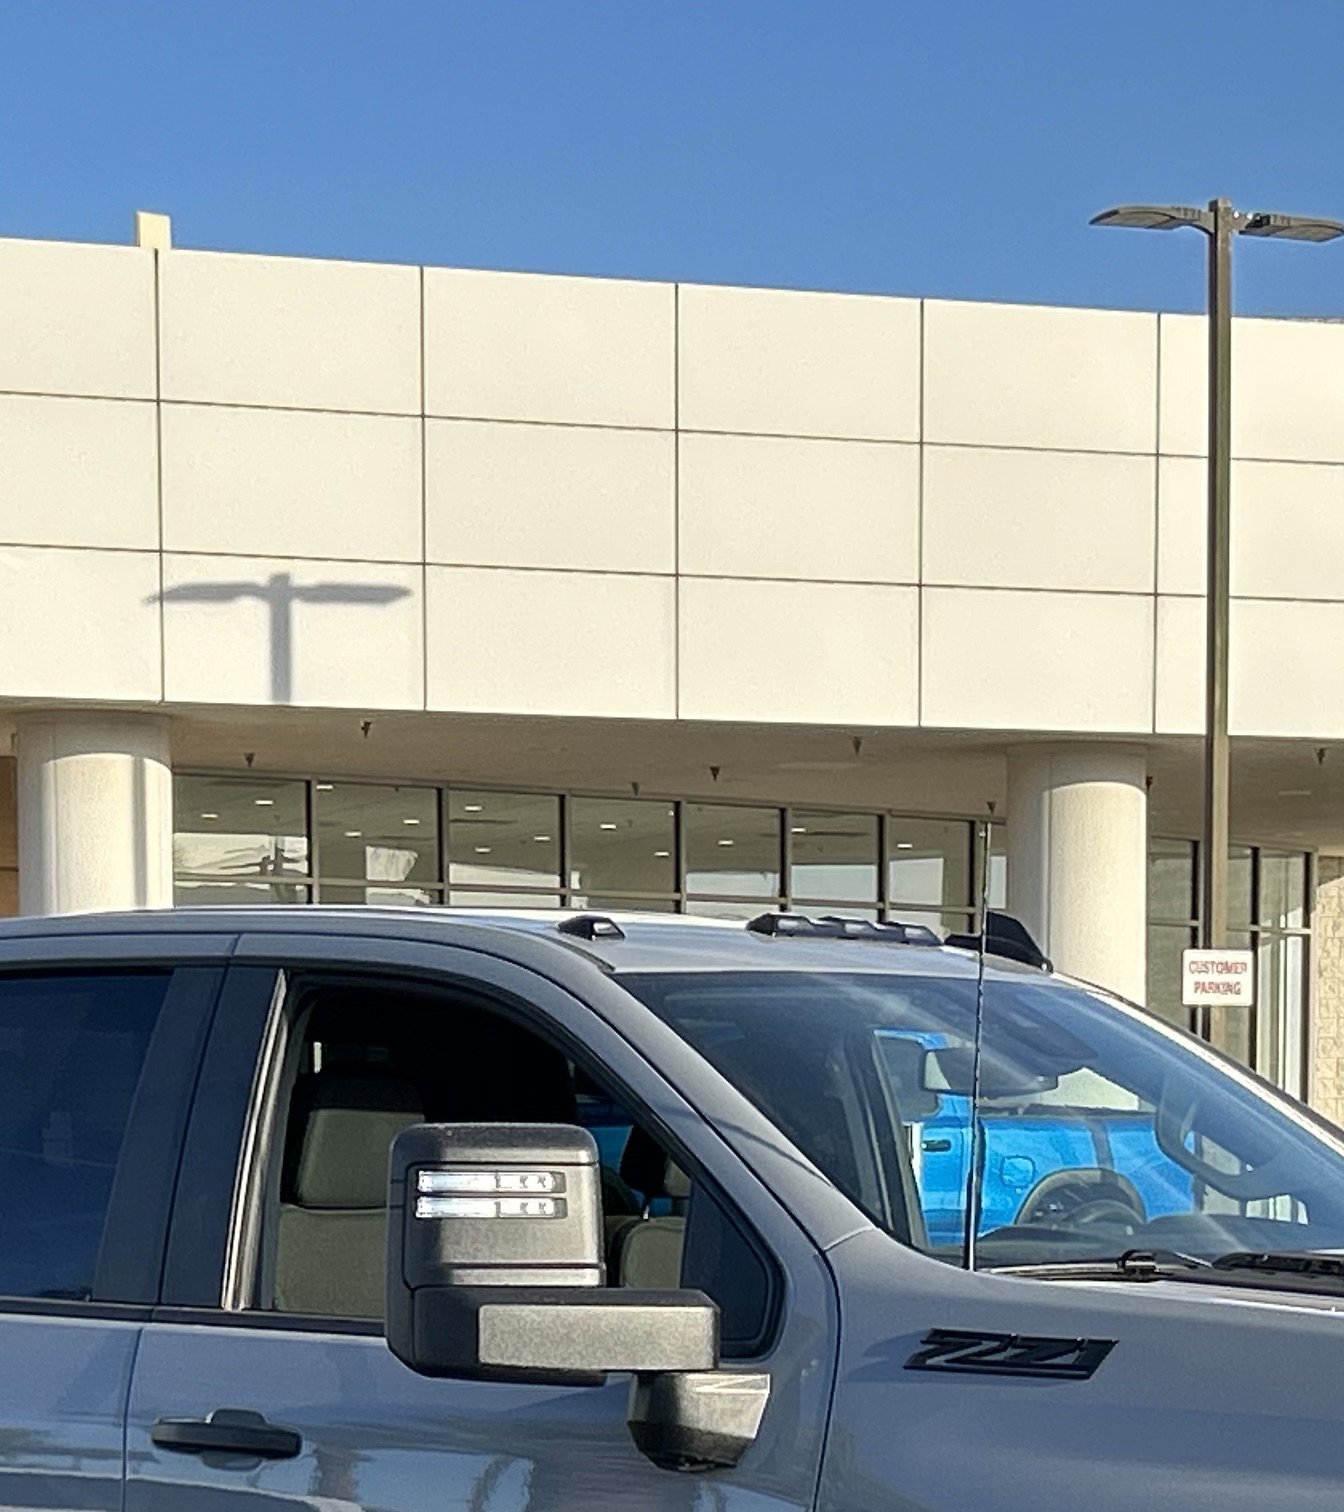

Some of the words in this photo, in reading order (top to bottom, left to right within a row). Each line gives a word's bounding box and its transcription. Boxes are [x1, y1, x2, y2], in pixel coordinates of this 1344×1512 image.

[1189, 961, 1247, 974] CUSTOMER
[1194, 982, 1241, 995] PARKING
[903, 1328, 1119, 1380] Z71
